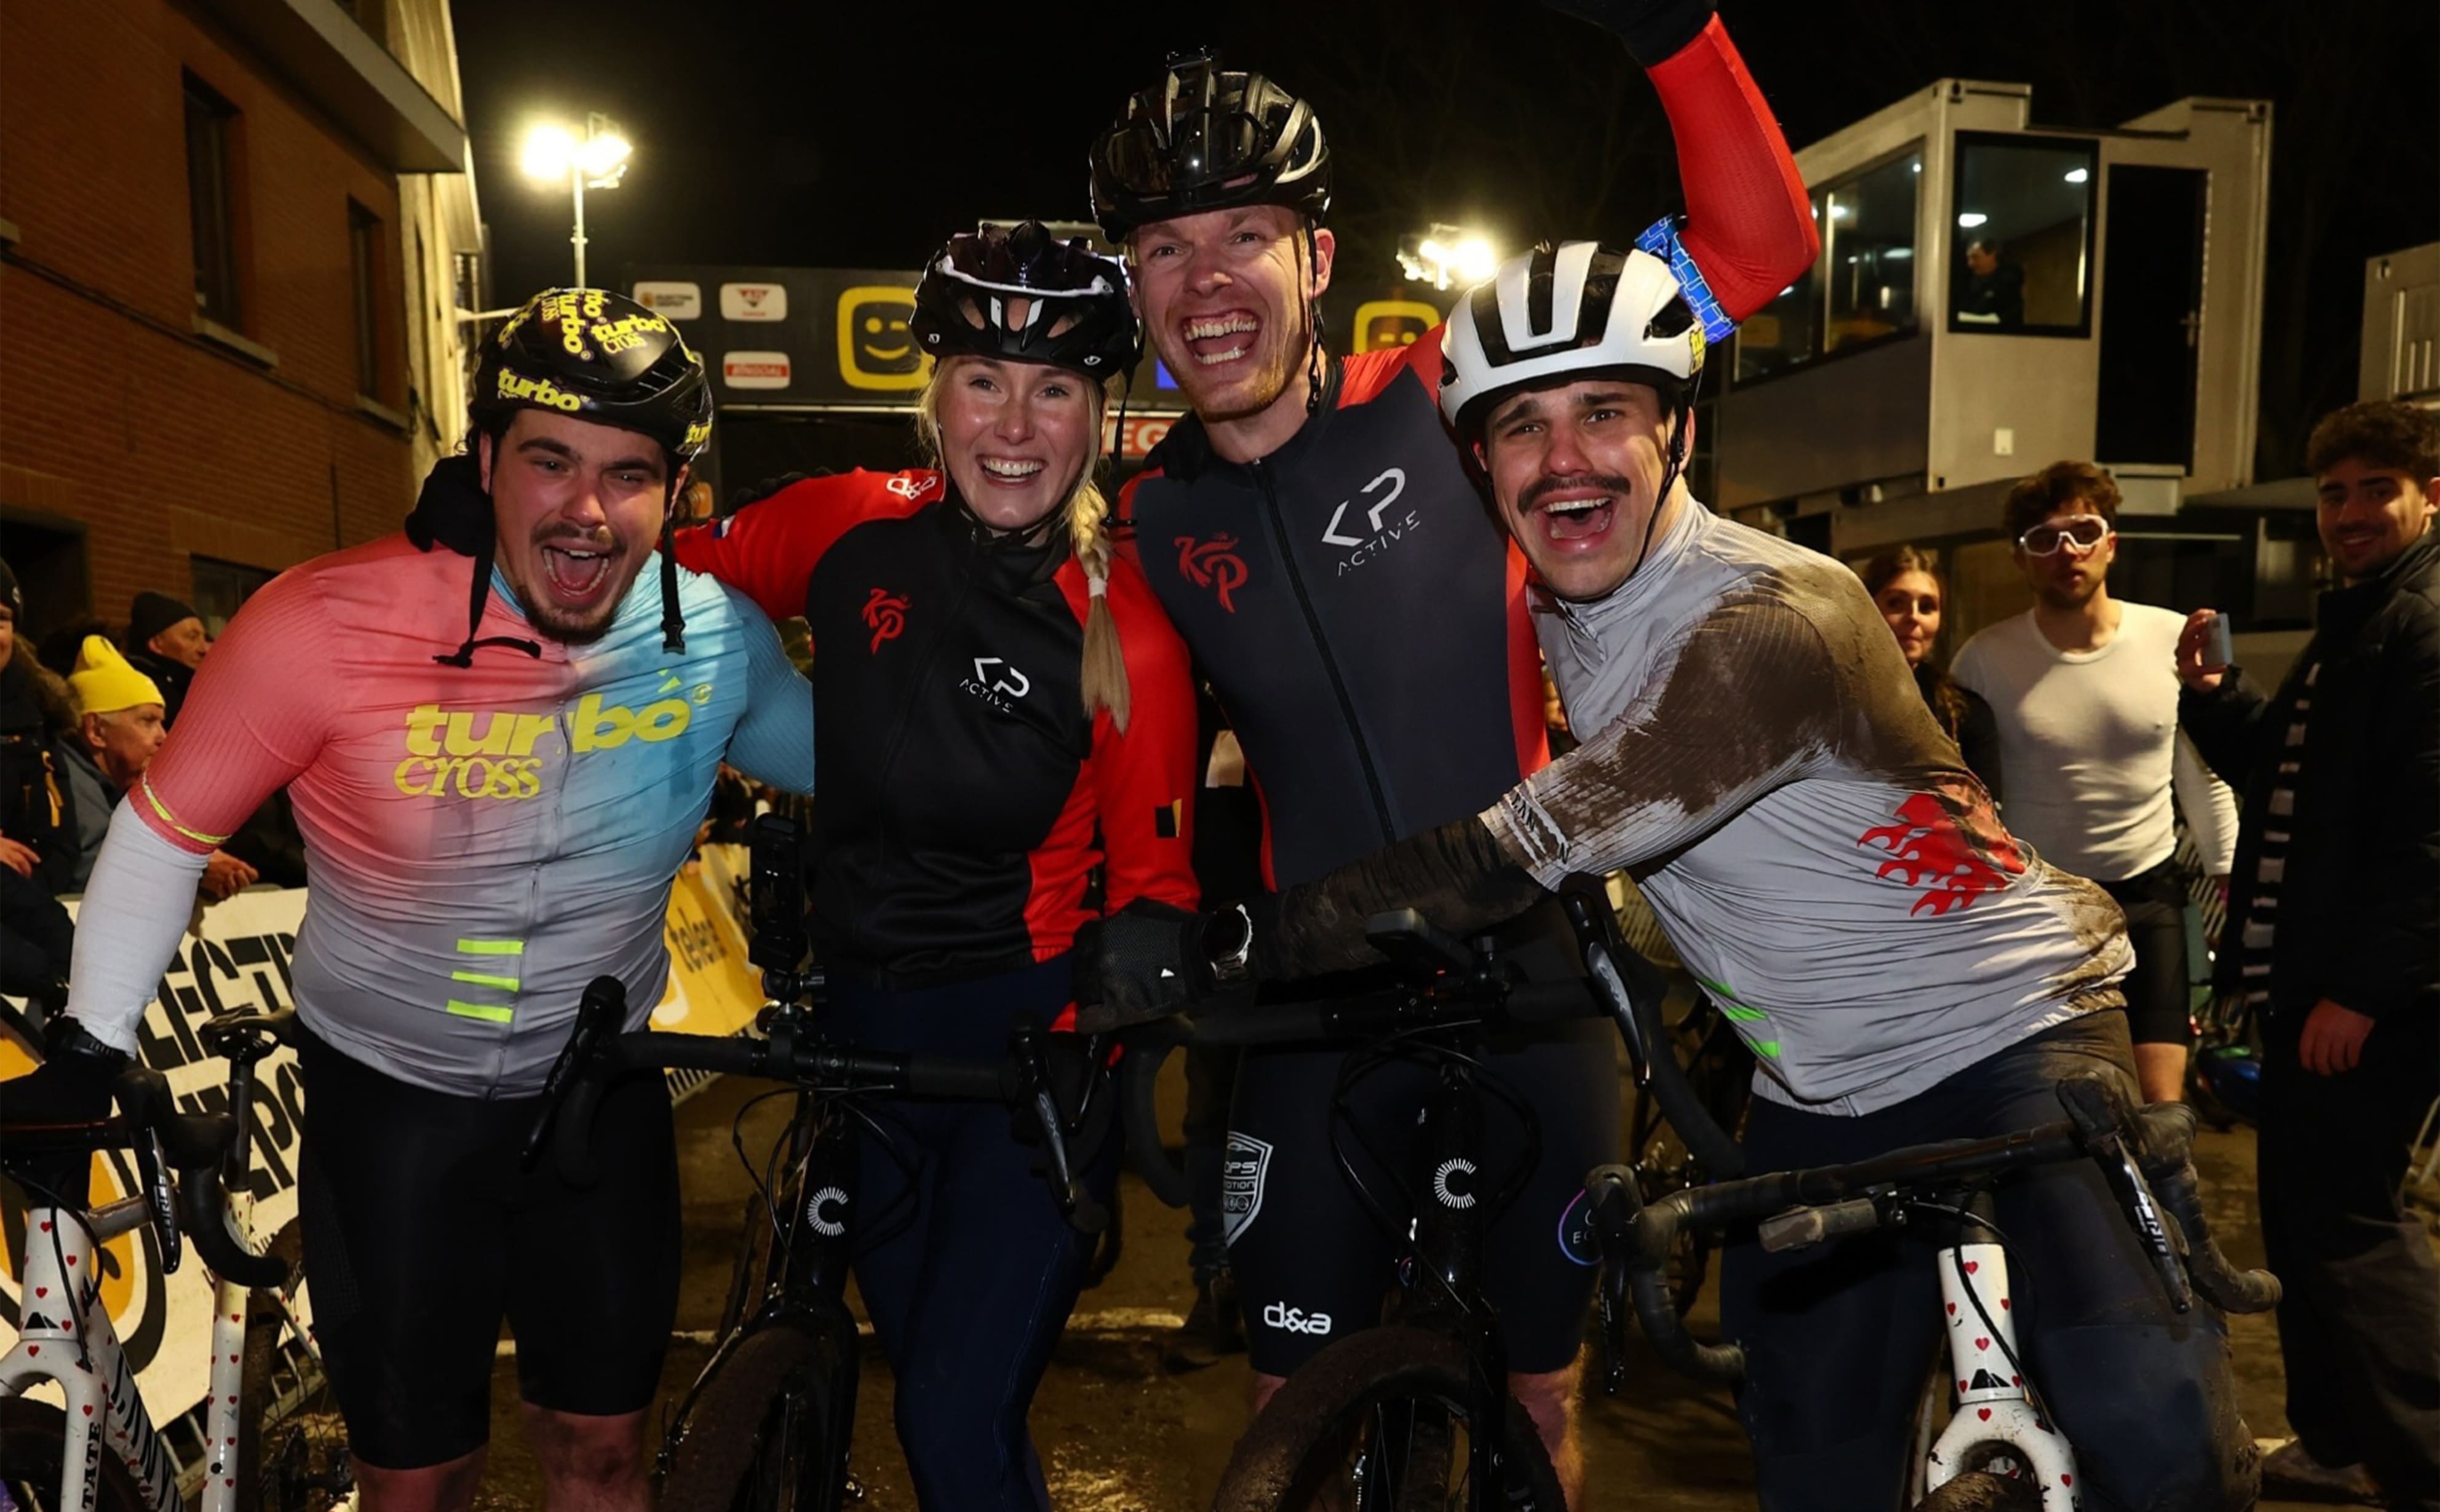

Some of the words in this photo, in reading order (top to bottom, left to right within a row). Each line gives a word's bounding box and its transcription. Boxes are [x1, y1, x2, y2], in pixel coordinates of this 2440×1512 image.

[591, 314, 667, 342] turbo
[603, 333, 648, 355] cross
[498, 368, 582, 412] turbo
[1337, 510, 1421, 577] ACTIVE
[960, 678, 1015, 714] ACTIVE
[394, 757, 543, 799] cross
[1264, 1301, 1331, 1335] d&a
